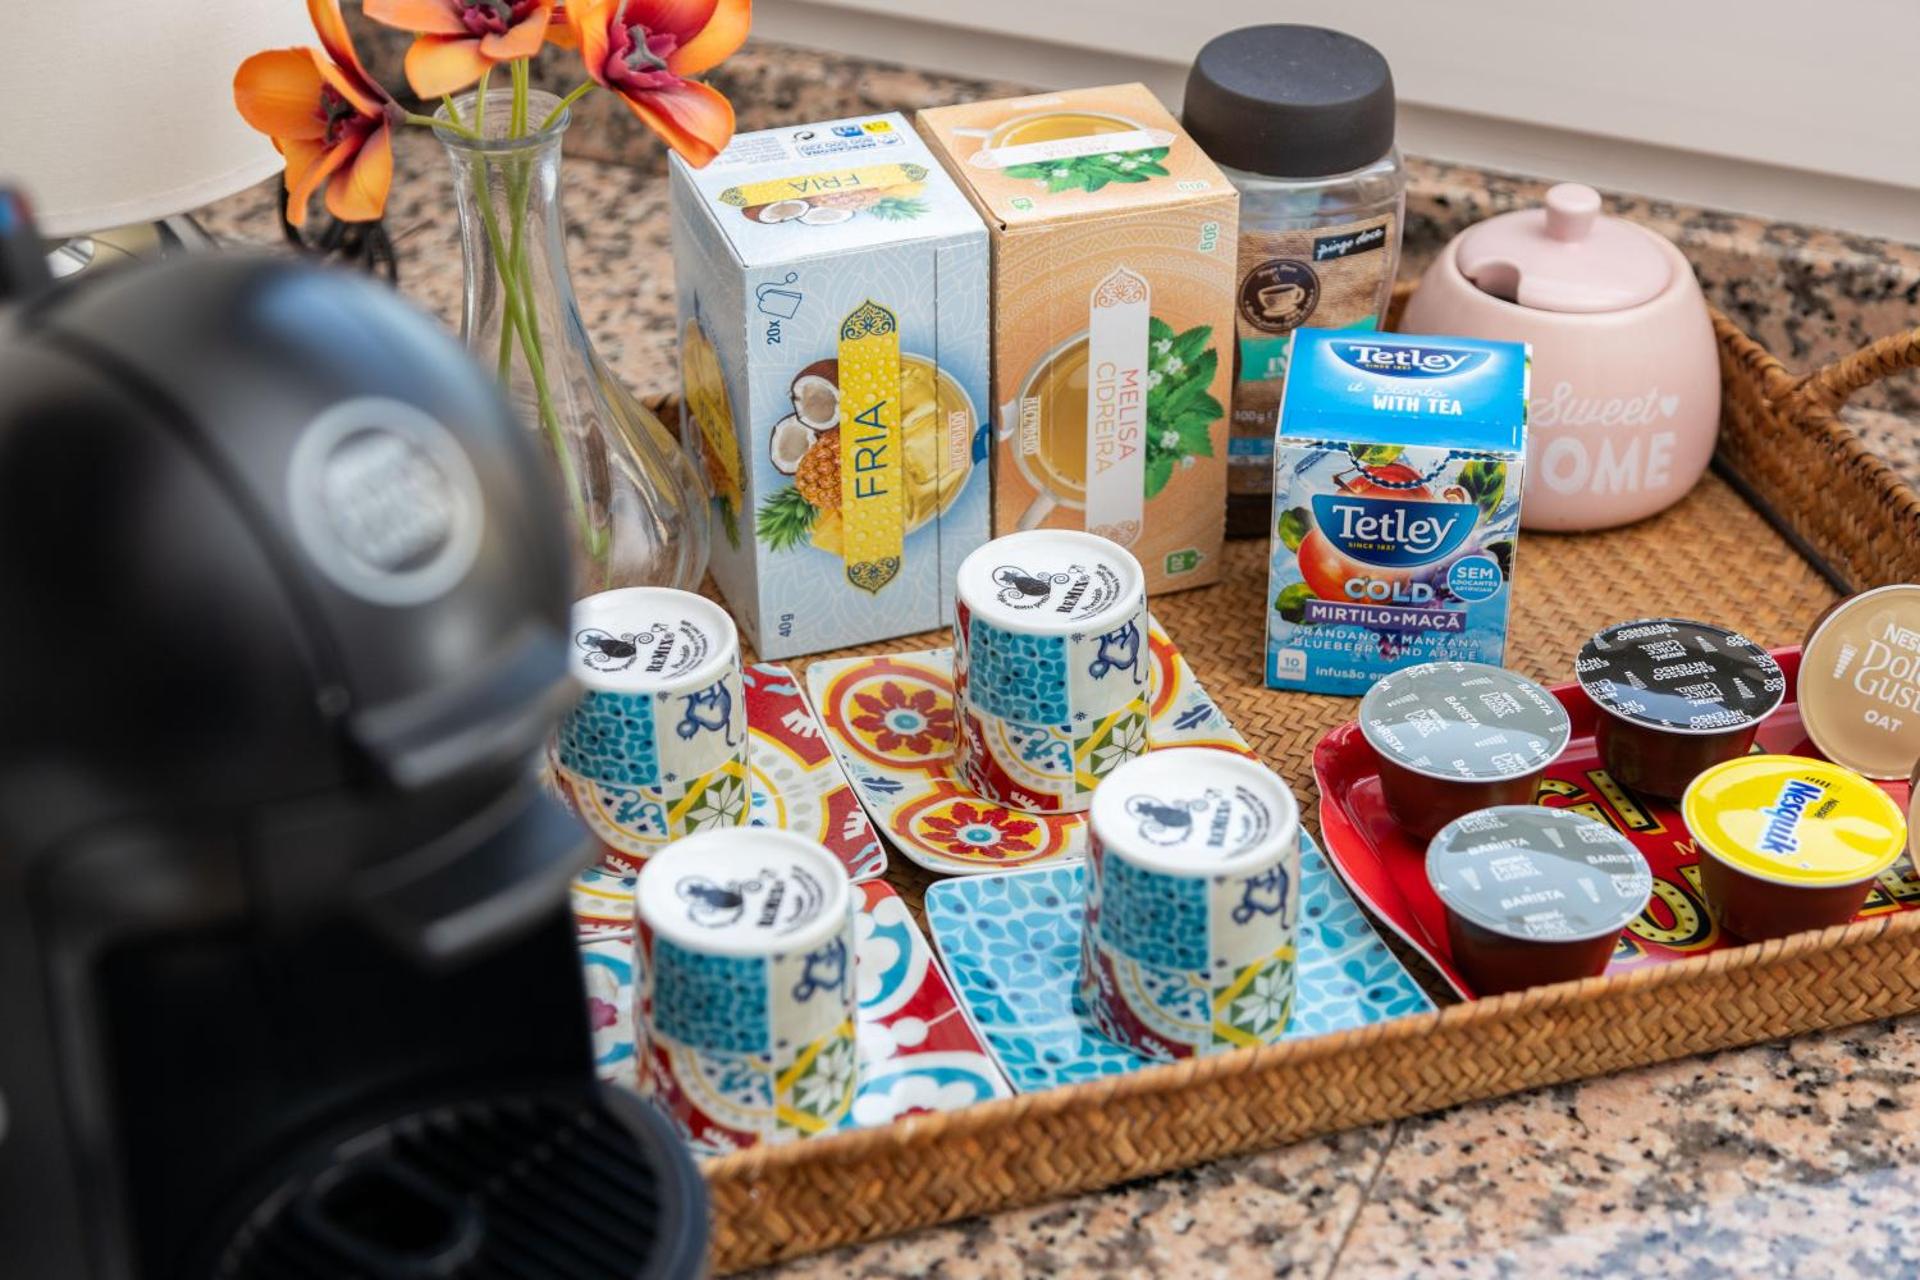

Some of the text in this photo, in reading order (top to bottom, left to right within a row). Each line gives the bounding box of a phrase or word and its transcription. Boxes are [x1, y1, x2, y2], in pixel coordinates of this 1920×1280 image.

[788, 173, 860, 193] FRIA
[1200, 223, 1217, 250] 30g
[1355, 228, 1383, 245] doce
[767, 320, 781, 345] 20x
[1349, 346, 1473, 373] Tetley
[1119, 368, 1140, 461] MELISA
[1373, 394, 1463, 416] WITH TEA
[1530, 380, 1661, 428] Sweet
[1095, 362, 1117, 476] CIDREIRA
[855, 400, 888, 499] FRIA
[1332, 504, 1457, 554] Tetley
[1348, 541, 1373, 550] SINCE
[1456, 566, 1494, 579] SEM
[1343, 577, 1434, 604] COLD
[778, 613, 794, 638] 40g
[1294, 637, 1478, 661] BLUEBERRY AND APPLE
[1386, 633, 1397, 643] Y
[1402, 635, 1480, 649] MANZANA
[1284, 656, 1300, 668] 10
[1517, 683, 1554, 716] BARISTA
[1444, 695, 1481, 730] BARISTA
[1690, 708, 1746, 724] INTENSO
[1864, 709, 1903, 733] OAT
[1369, 718, 1406, 753] BARISTA
[1762, 779, 1823, 855] Nesquik
[1467, 837, 1531, 856] BARISTA
[1500, 889, 1567, 911] BARISTA
